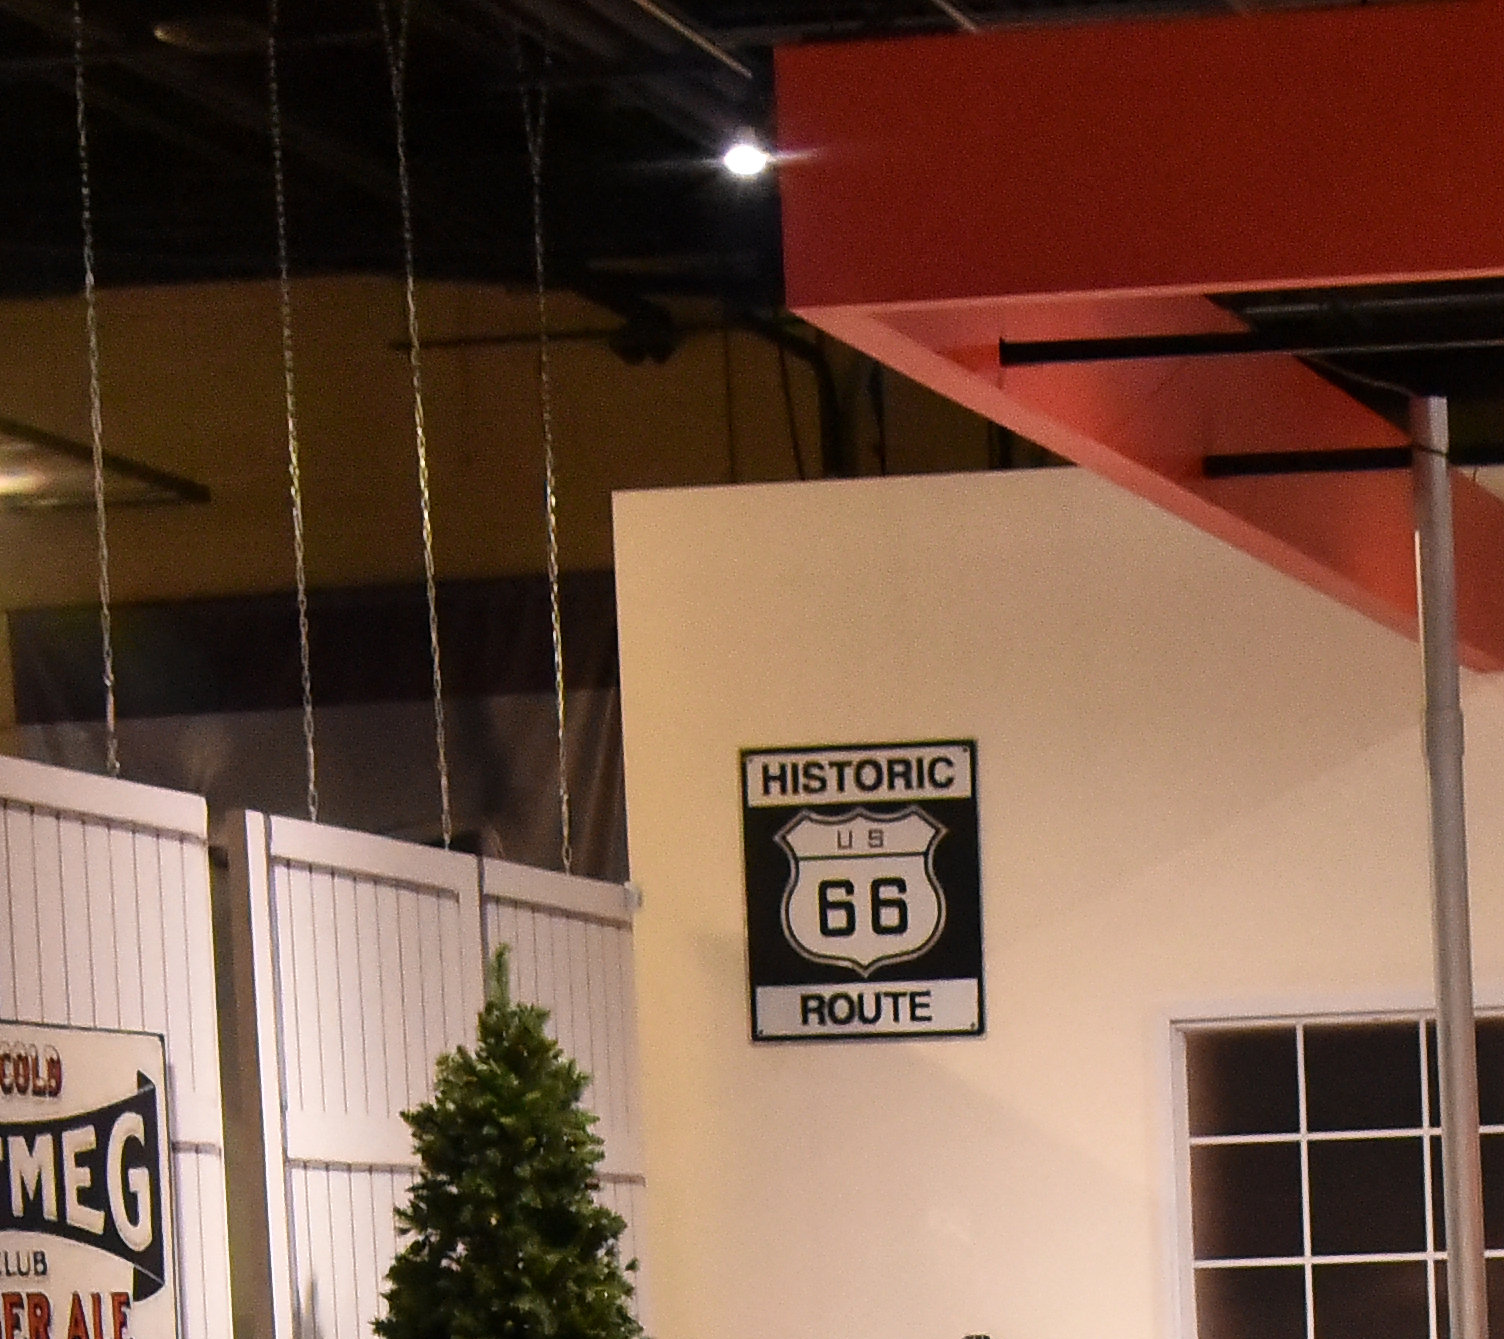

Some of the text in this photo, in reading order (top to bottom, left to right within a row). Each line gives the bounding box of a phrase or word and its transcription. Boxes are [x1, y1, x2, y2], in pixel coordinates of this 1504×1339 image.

[762, 757, 955, 795] HISTORIC
[836, 829, 885, 850] US
[818, 876, 909, 937] 66
[800, 990, 933, 1026] ROUTE
